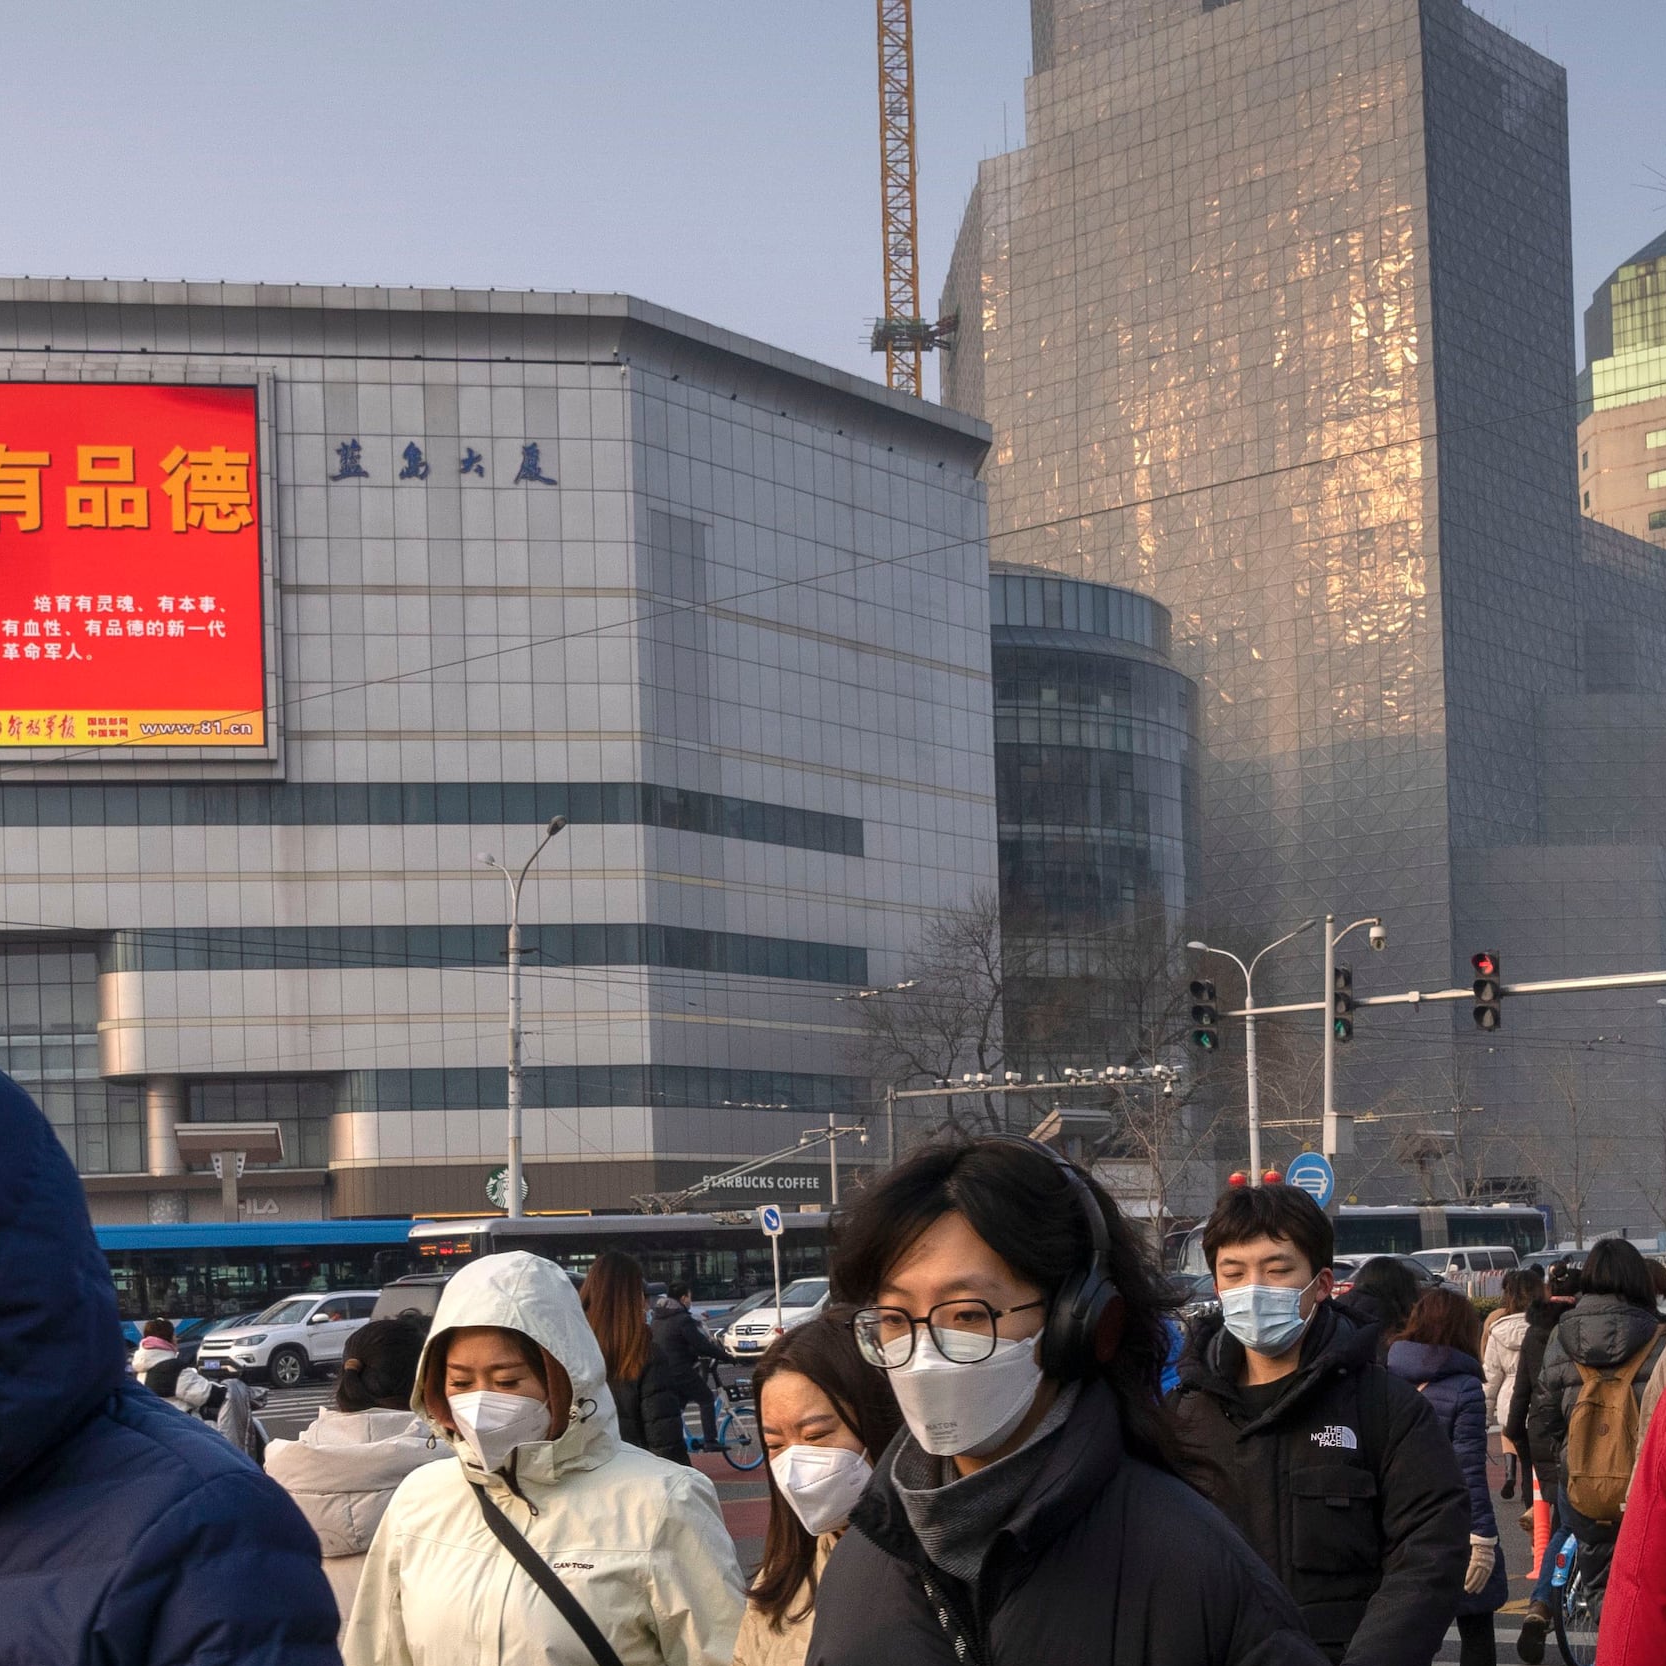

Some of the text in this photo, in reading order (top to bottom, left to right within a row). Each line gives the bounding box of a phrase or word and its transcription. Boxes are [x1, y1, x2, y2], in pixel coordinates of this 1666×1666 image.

[33, 594, 228, 613] 培育有灵魂、有本事、
[1, 618, 227, 638] 有血性、有品德的新一代
[2, 642, 93, 661] 革命军人。
[140, 720, 253, 736] www.81.cn
[777, 1177, 820, 1189] COFFEE
[1324, 1425, 1342, 1433] THE
[1310, 1432, 1342, 1441] NORTH
[1319, 1439, 1342, 1448] FACE
